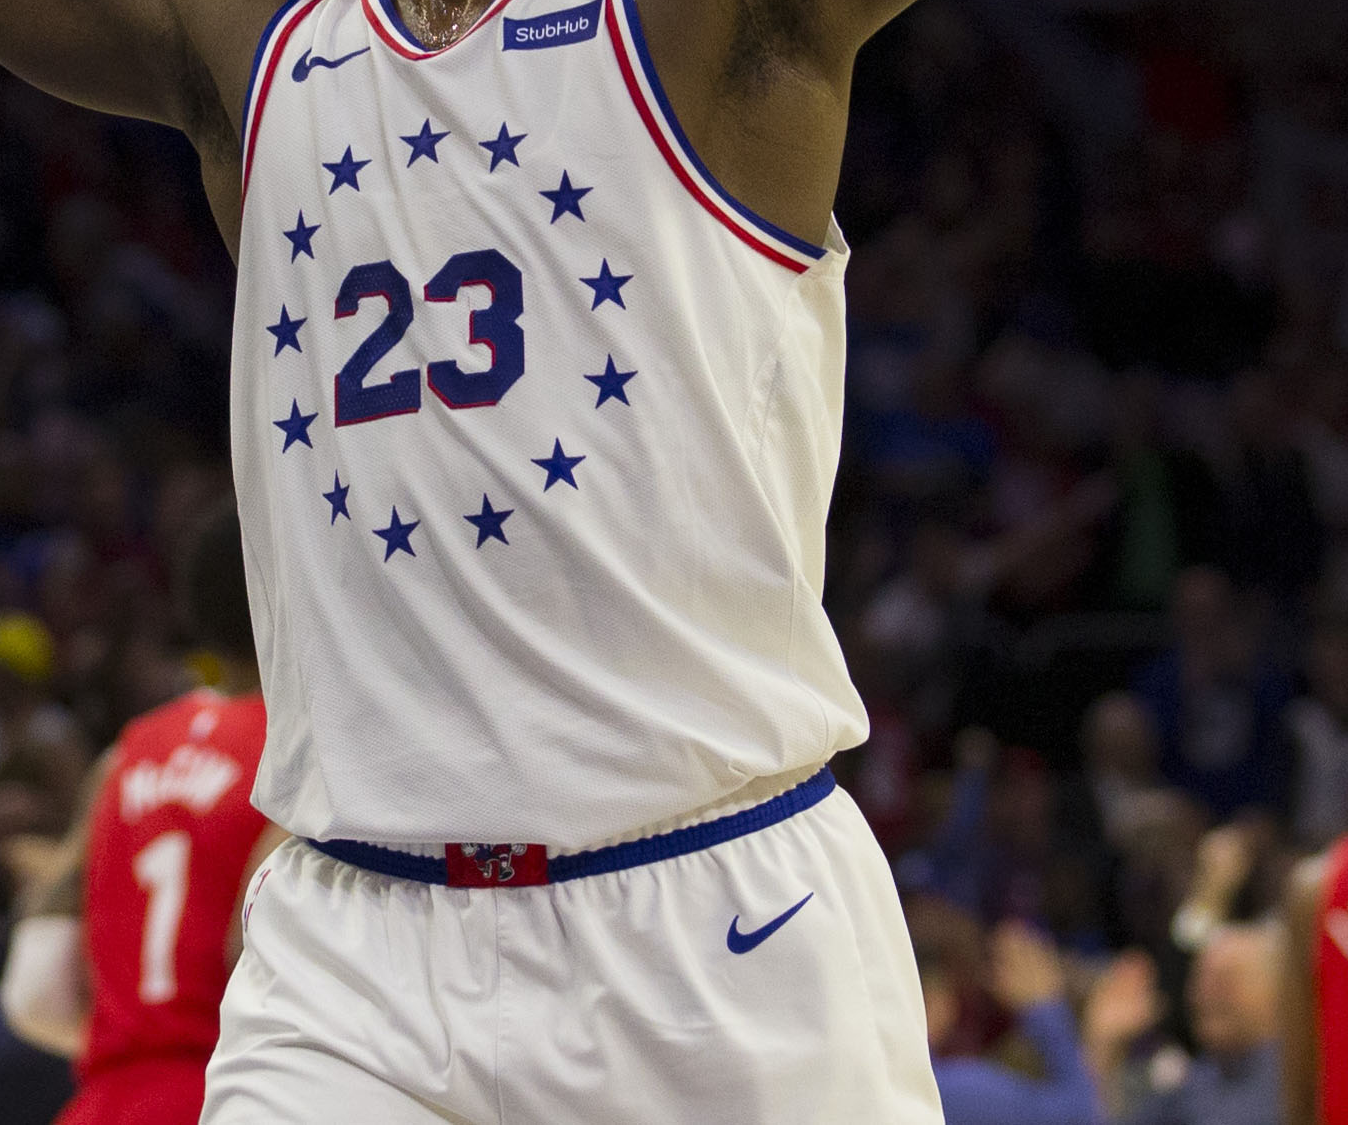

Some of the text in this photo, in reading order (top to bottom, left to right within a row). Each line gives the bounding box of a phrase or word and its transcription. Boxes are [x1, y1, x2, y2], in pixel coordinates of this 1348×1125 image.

[515, 16, 589, 42] StubHub
[335, 248, 525, 428] 23
[133, 831, 192, 1004] 1
